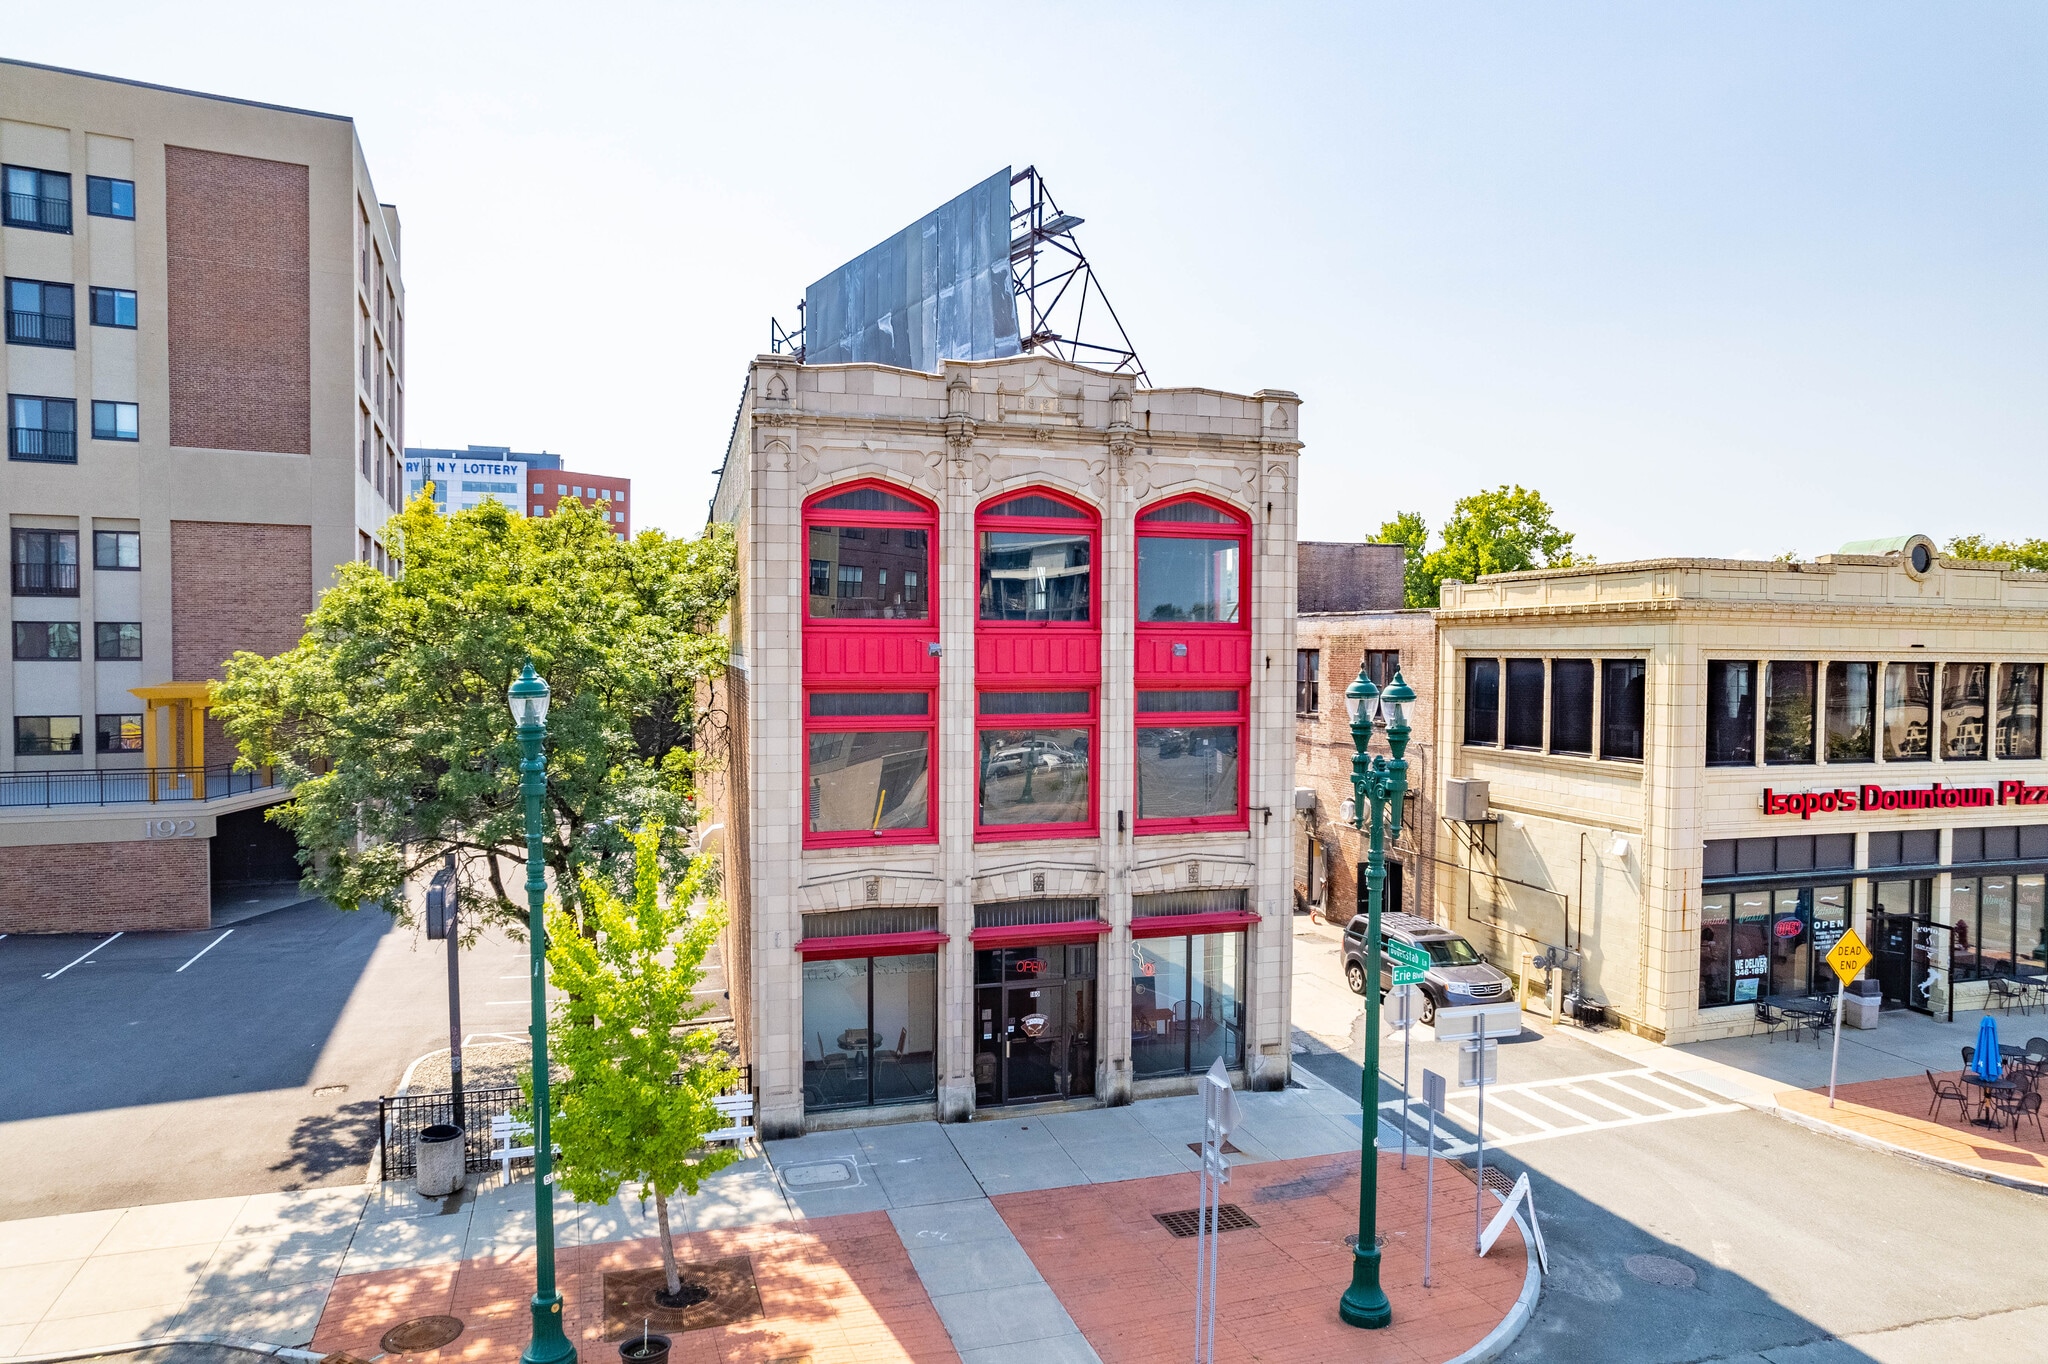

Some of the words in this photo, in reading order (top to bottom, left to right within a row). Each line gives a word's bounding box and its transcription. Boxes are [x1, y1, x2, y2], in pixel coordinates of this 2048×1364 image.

[463, 463, 518, 476] LOTTERY
[1763, 788, 1857, 820] Isopo's
[1860, 782, 1995, 812] Downtown
[145, 819, 197, 839] 192
[1776, 922, 1800, 935] OPEN
[1813, 919, 1844, 930] OPEN
[1838, 946, 1862, 956] DEAD
[1016, 961, 1047, 972] OPEN
[1735, 959, 1744, 969] WE
[1744, 957, 1768, 969] DELIVER
[1840, 960, 1857, 970] END
[1394, 969, 1411, 982] Erie
[1735, 968, 1767, 976] 346-1891
